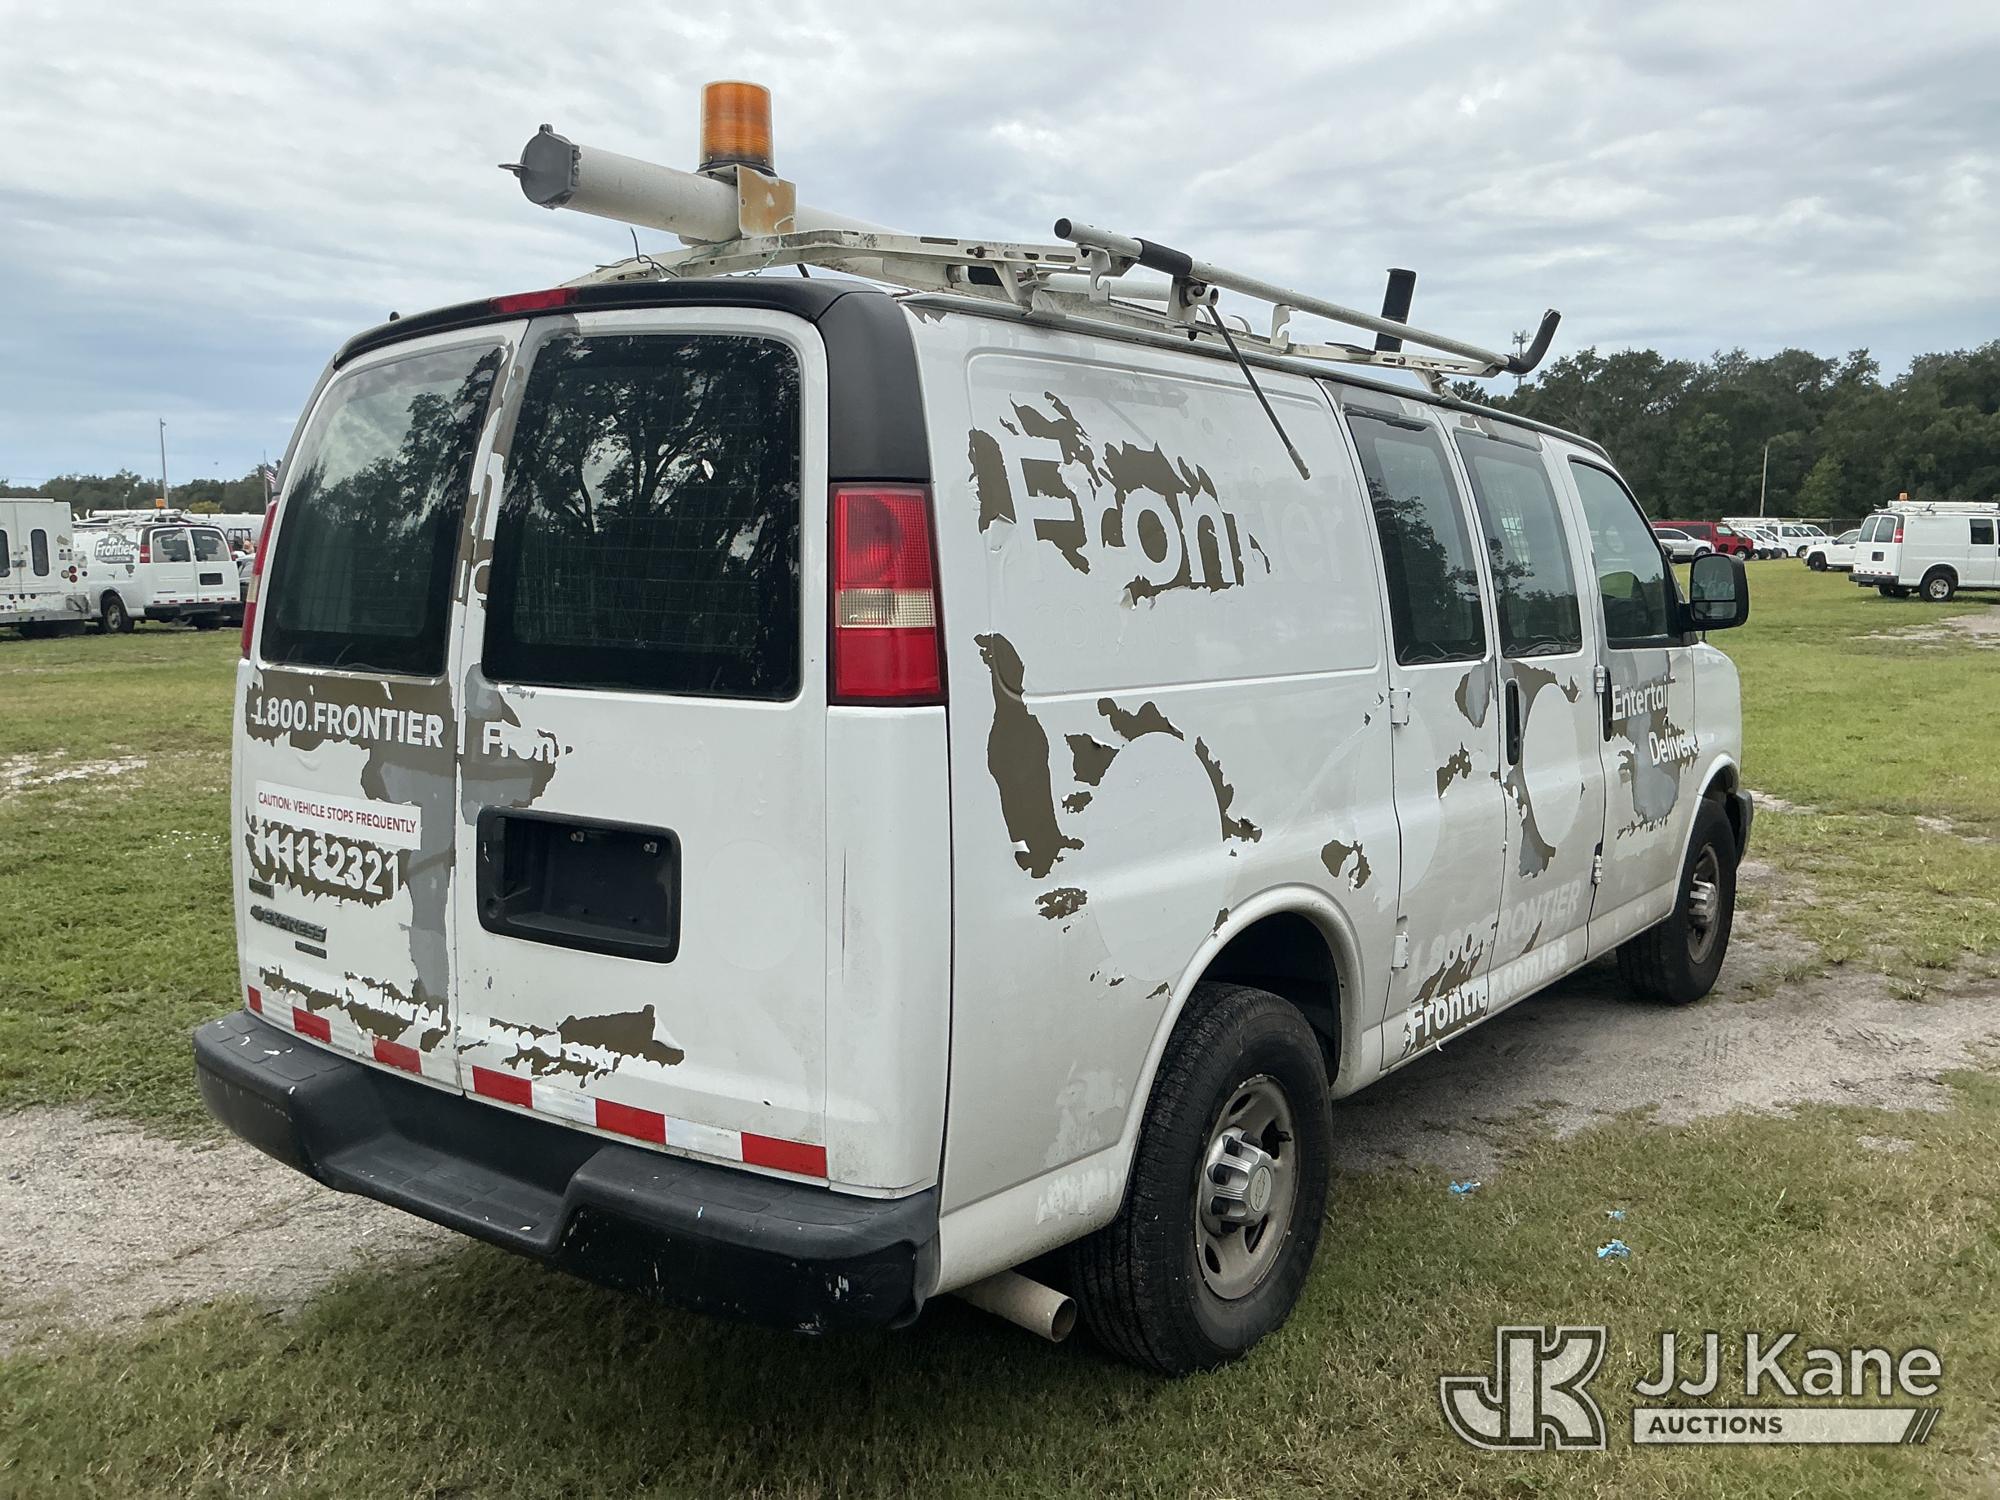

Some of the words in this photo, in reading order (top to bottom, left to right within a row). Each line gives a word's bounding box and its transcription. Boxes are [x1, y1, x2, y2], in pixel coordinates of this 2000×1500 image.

[258, 792, 292, 811] CAUTION:
[293, 800, 325, 818] VEHICLE
[327, 807, 354, 823] STOPS
[356, 812, 417, 834] FREQUENTLY
